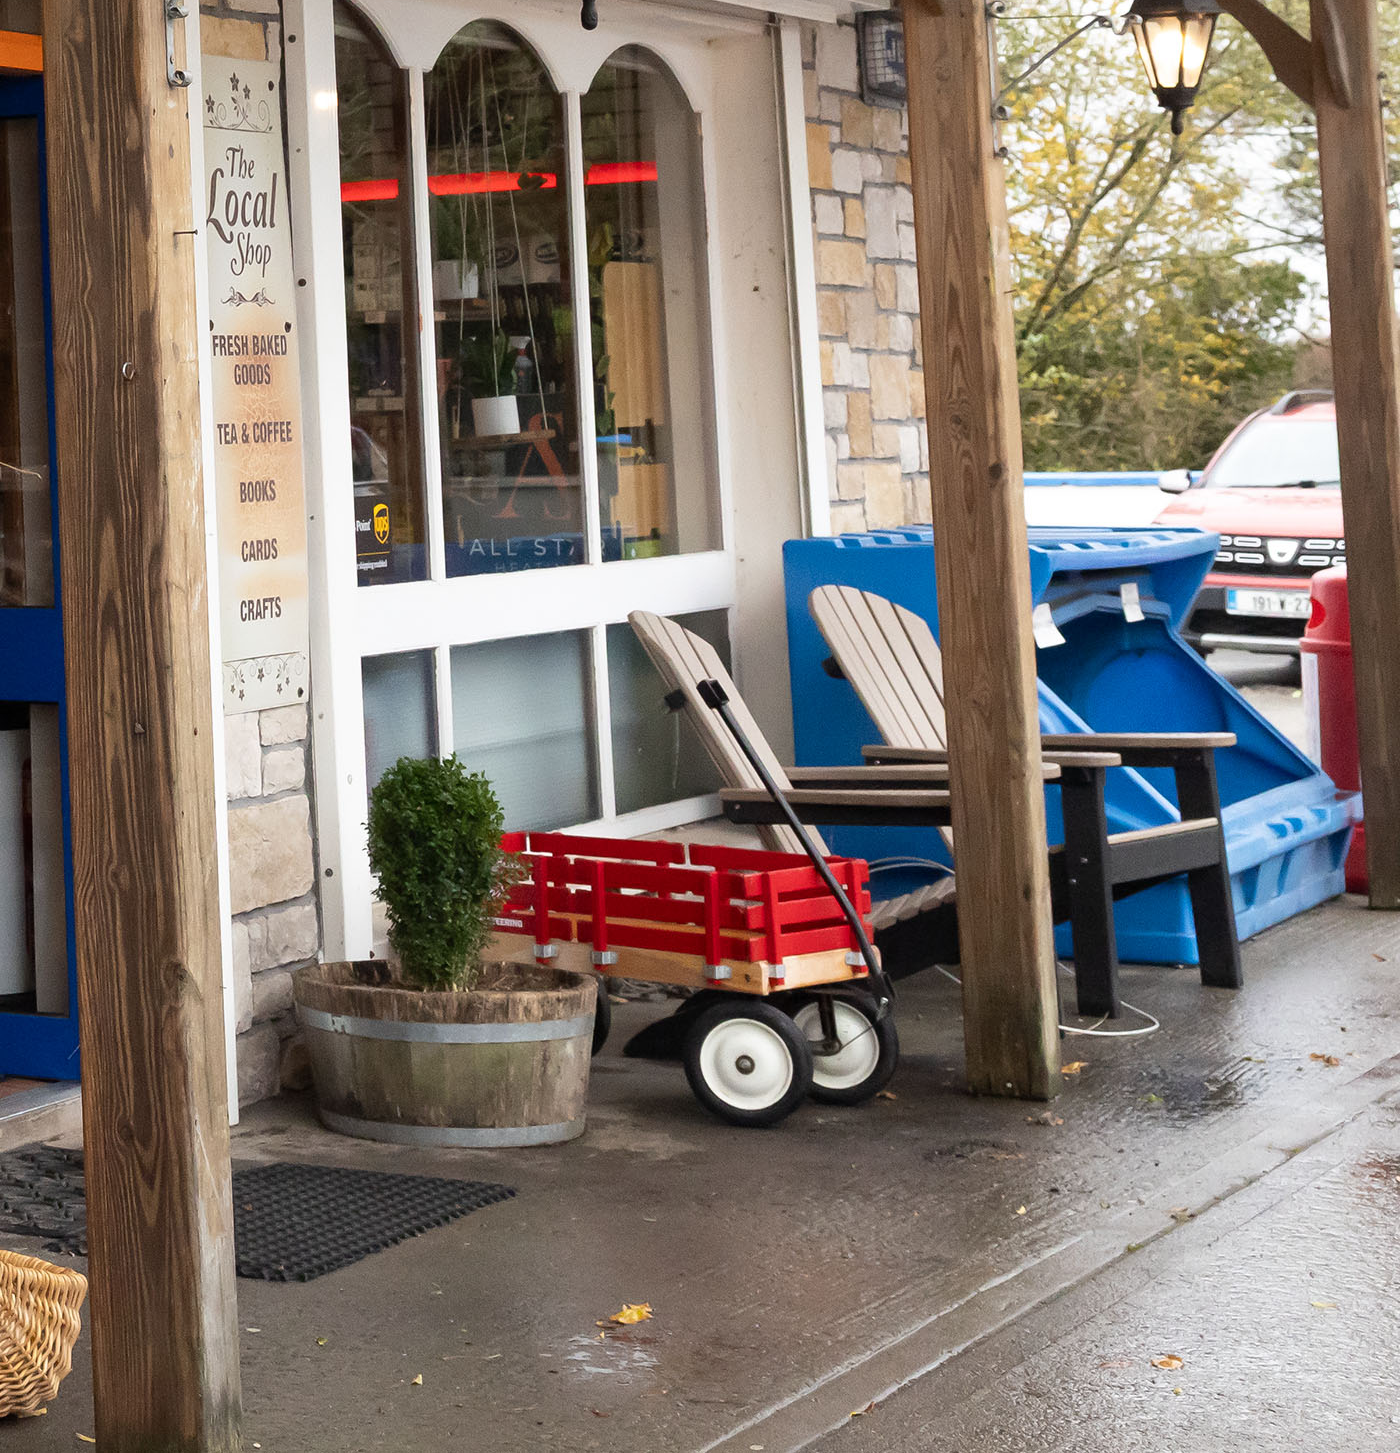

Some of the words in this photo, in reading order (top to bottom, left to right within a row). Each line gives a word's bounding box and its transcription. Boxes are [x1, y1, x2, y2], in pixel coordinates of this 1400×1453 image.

[226, 144, 255, 178] The
[206, 168, 278, 244] Local
[230, 232, 272, 278] Shop
[212, 335, 249, 356] FRESH
[252, 335, 287, 356] BAKED
[234, 363, 271, 385] GOODS
[217, 423, 238, 445] TEA
[241, 422, 250, 444] &
[253, 421, 293, 443] COFFEE
[240, 479, 277, 503] BOOKS
[241, 538, 278, 562] CARDS
[469, 539, 517, 556] ALL
[240, 596, 282, 622] CRAFTS
